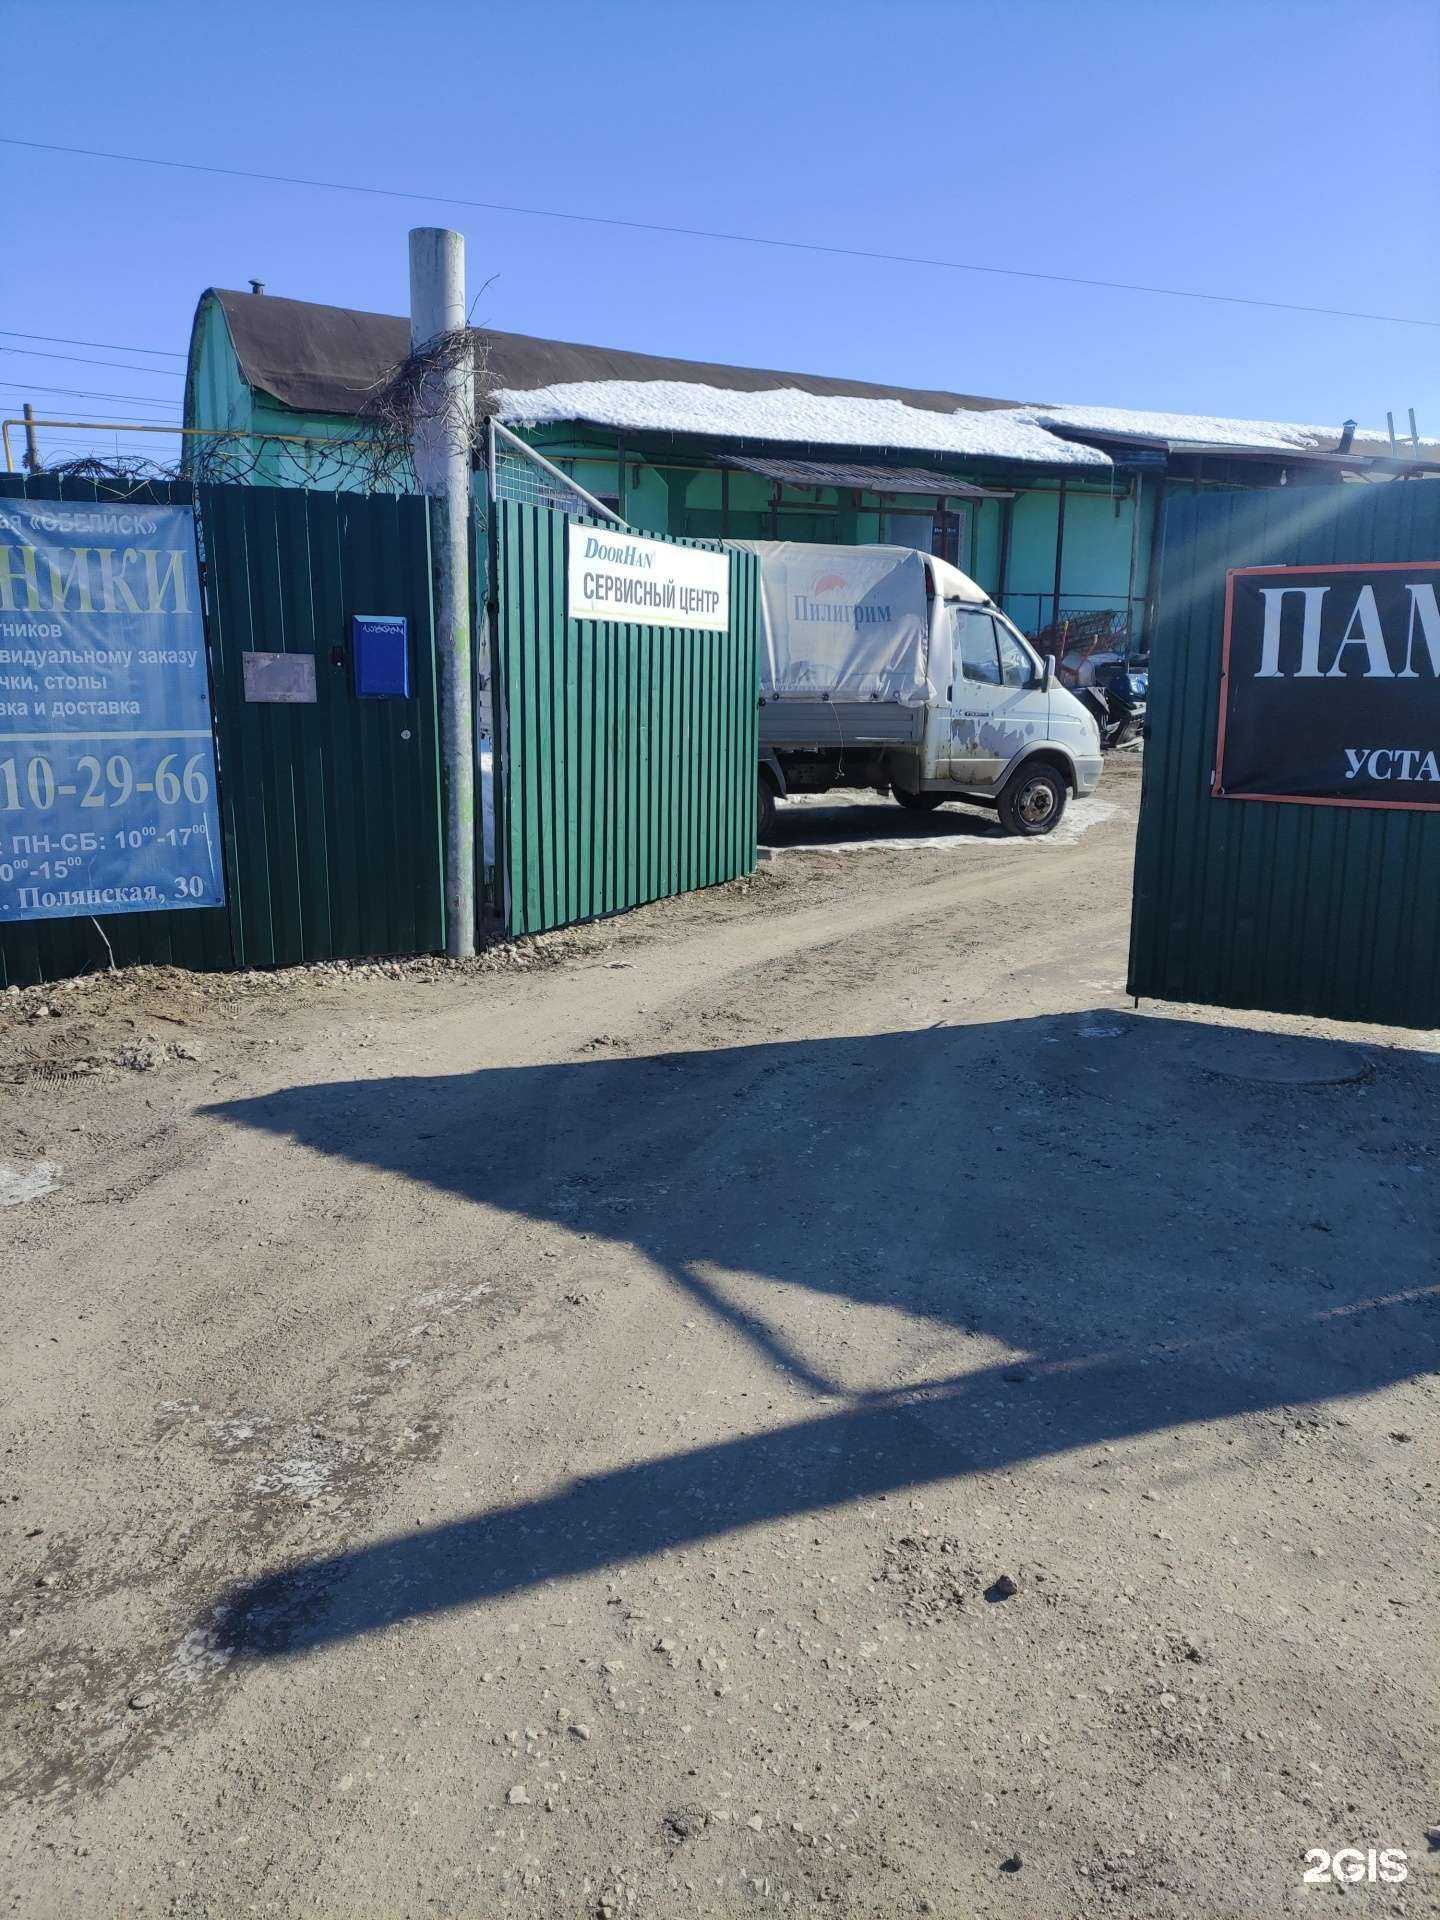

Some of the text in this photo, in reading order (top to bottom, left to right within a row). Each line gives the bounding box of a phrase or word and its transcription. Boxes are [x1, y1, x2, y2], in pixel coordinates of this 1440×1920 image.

[583, 571, 720, 615] СЕРВИСНЫЙ ЦЕНТР
[794, 595, 892, 631] Пилигрим
[0, 649, 198, 667] видуальному заказу
[44, 676, 107, 690] столы
[34, 701, 46, 714] и
[52, 700, 140, 718] доставка
[0, 752, 209, 810] 10-29-66
[12, 832, 106, 854] ПН-СБ:
[16, 884, 165, 910] Полянская,
[174, 875, 204, 898] 30
